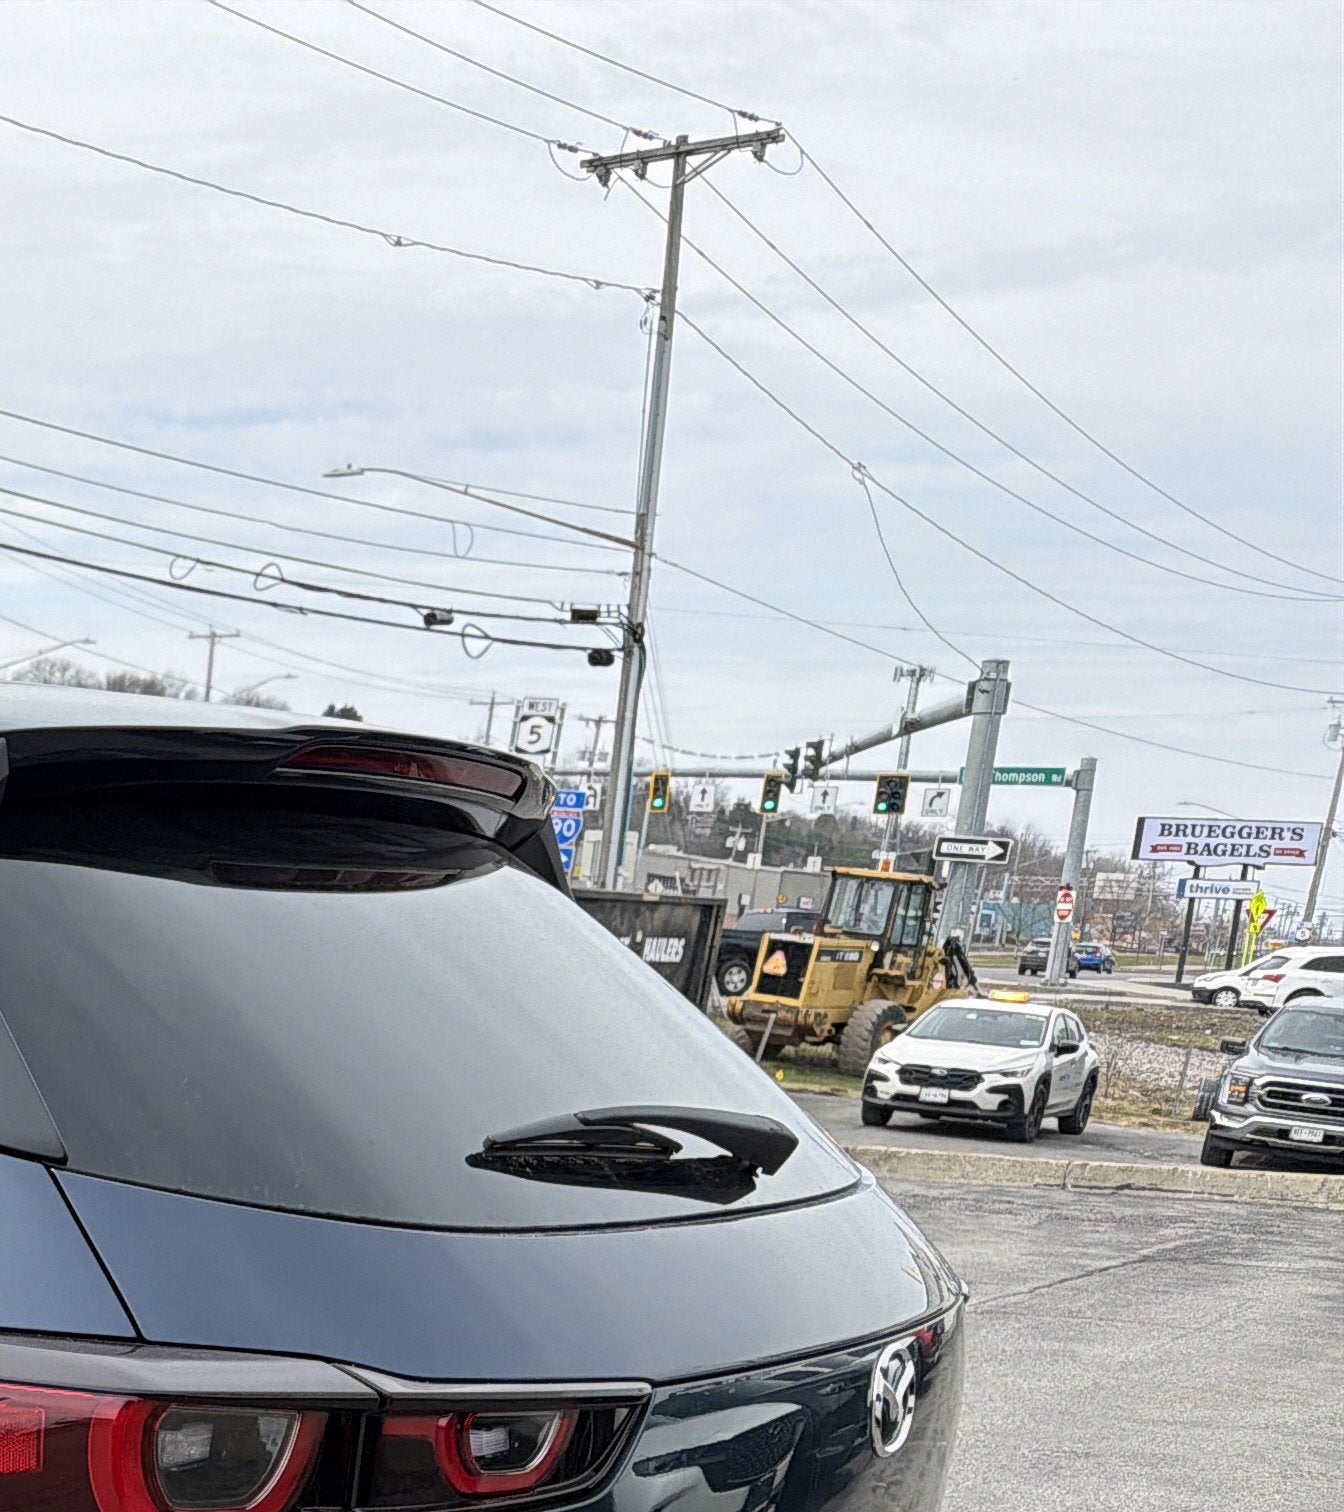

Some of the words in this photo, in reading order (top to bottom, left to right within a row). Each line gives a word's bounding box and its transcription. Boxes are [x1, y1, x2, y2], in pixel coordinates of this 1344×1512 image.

[528, 702, 553, 712] WEST
[527, 725, 543, 745] 5
[557, 793, 577, 805] TO
[552, 818, 576, 838] 90
[1157, 822, 1305, 842] BRUEGGER'S
[946, 844, 963, 852] ONE
[968, 845, 986, 853] WAY
[1184, 841, 1272, 859] BAGELS
[1189, 882, 1231, 895] thrive
